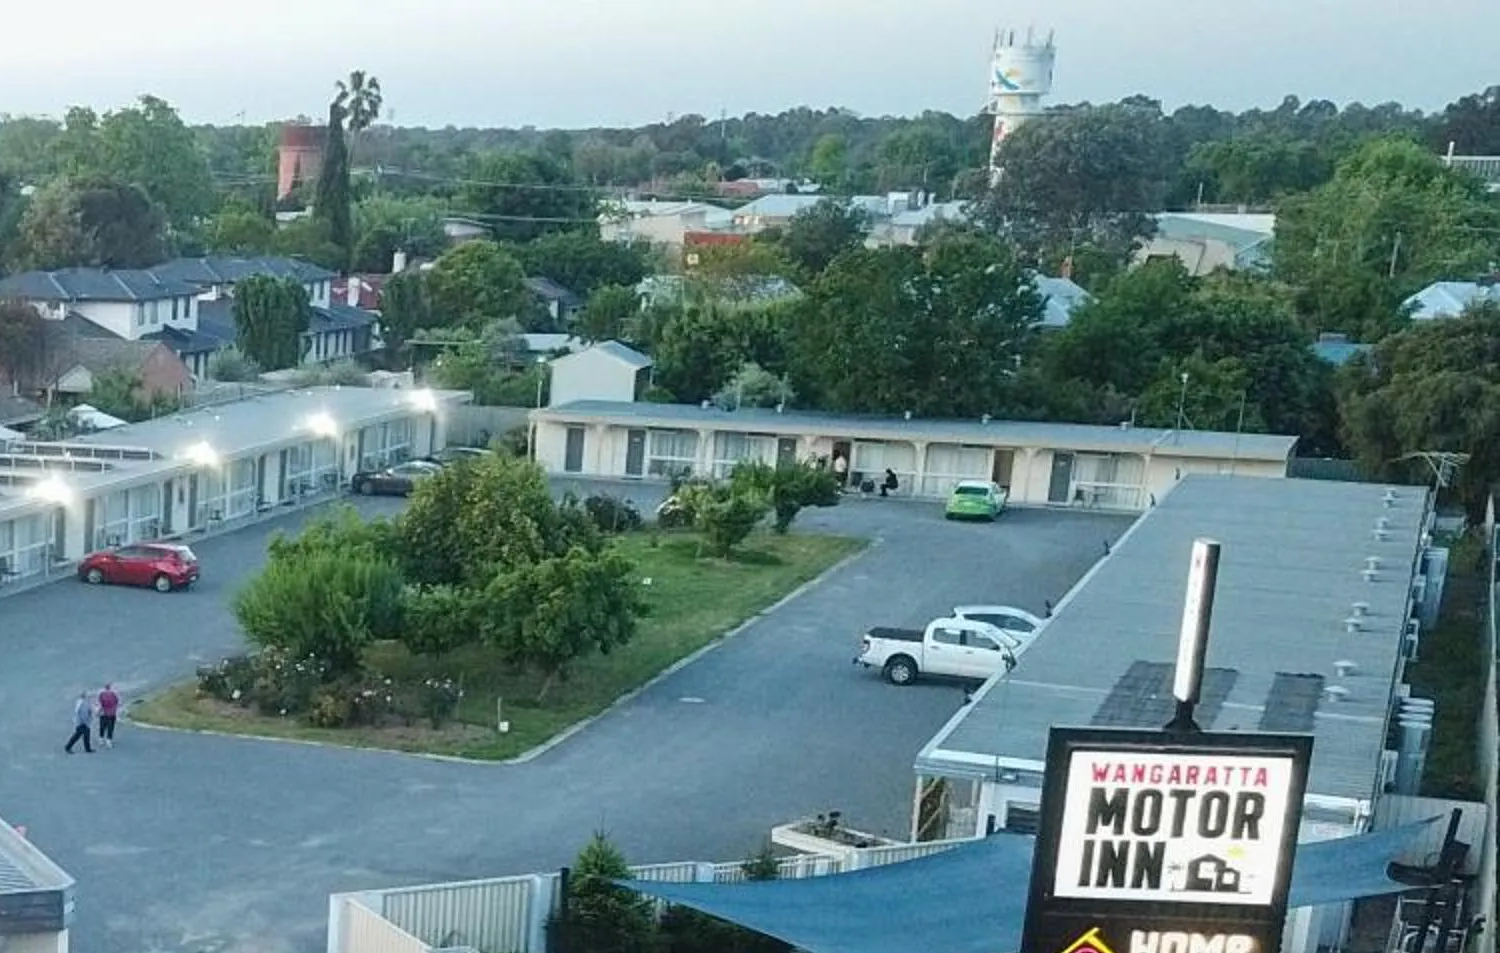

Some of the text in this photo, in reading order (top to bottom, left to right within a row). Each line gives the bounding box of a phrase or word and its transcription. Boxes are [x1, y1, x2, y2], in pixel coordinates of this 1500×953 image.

[1091, 762, 1268, 786] WANGARATTA
[1085, 787, 1265, 840] MOTOR
[1077, 840, 1167, 890] INN
